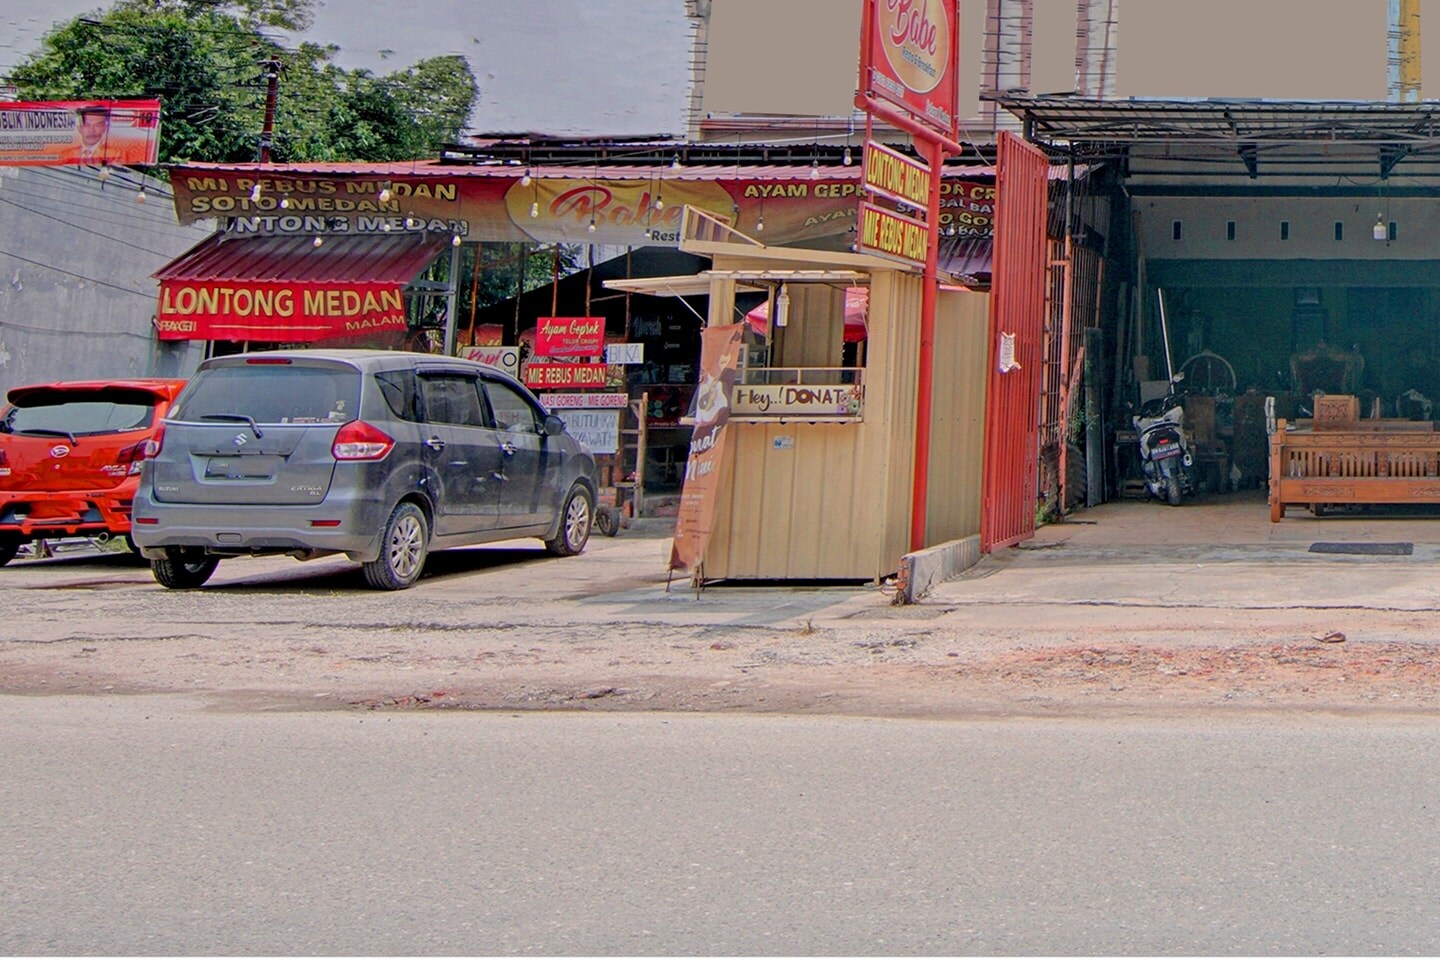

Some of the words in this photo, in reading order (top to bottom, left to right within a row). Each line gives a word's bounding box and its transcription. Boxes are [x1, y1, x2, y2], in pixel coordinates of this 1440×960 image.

[0, 111, 21, 129] BLIK
[25, 111, 76, 129] INDONESIA
[867, 146, 905, 195] LONTONG
[905, 163, 930, 206] MEDAN
[236, 178, 337, 194] REBUS
[744, 184, 807, 198] AYAM
[191, 196, 278, 212] SOTO
[287, 197, 400, 213] MEDAN
[357, 216, 470, 236] MEDAN
[863, 208, 879, 247] MIE
[879, 214, 904, 255] REBUS
[903, 221, 929, 262] MEDAN
[161, 286, 294, 317] LONTONG
[304, 288, 402, 317] MEDAN
[346, 314, 405, 331] MALAM
[540, 319, 567, 342] Ayam
[570, 319, 600, 339] Geprek
[528, 367, 543, 384] MIE
[546, 367, 572, 384] REBUS
[574, 367, 606, 384] MEDAN
[541, 395, 556, 406] NASI
[557, 395, 583, 407] GORENG
[588, 395, 600, 406] MIE
[601, 395, 627, 407] GORENG
[785, 387, 843, 406] DONAT
